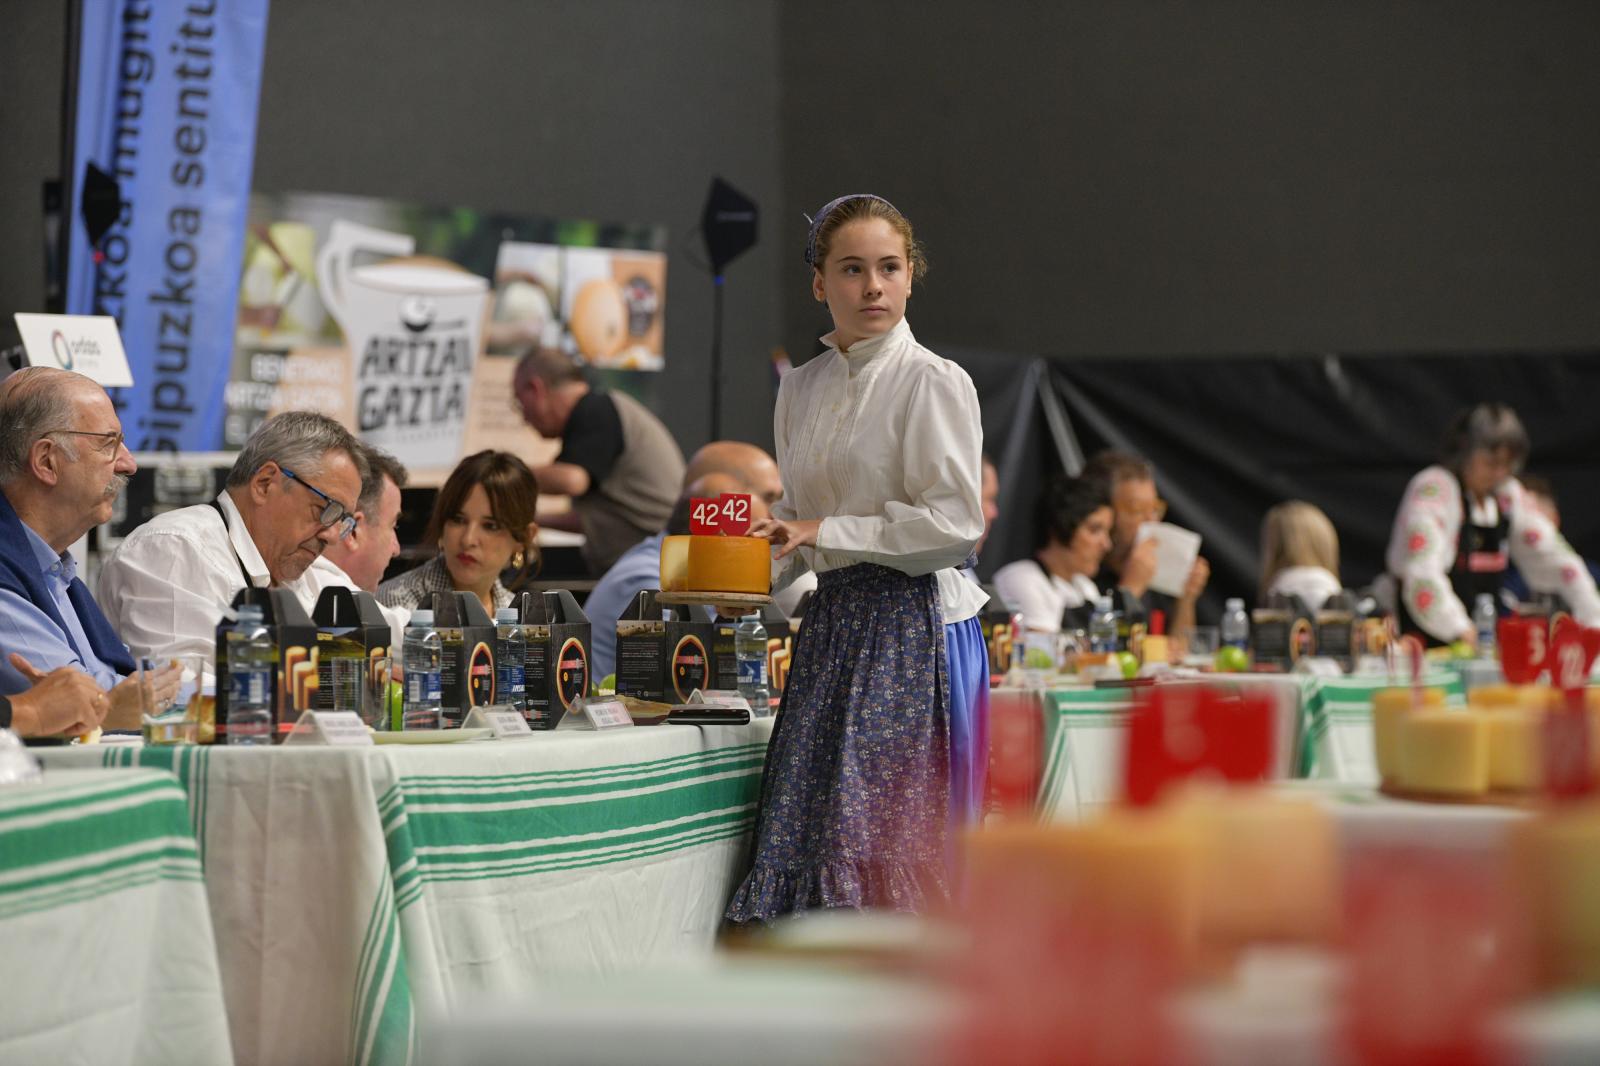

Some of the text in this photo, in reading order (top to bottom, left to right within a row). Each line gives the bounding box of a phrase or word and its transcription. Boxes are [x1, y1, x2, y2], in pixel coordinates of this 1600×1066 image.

[358, 380, 465, 431] GAZTA
[692, 503, 719, 526] 42
[721, 498, 748, 522] 42
